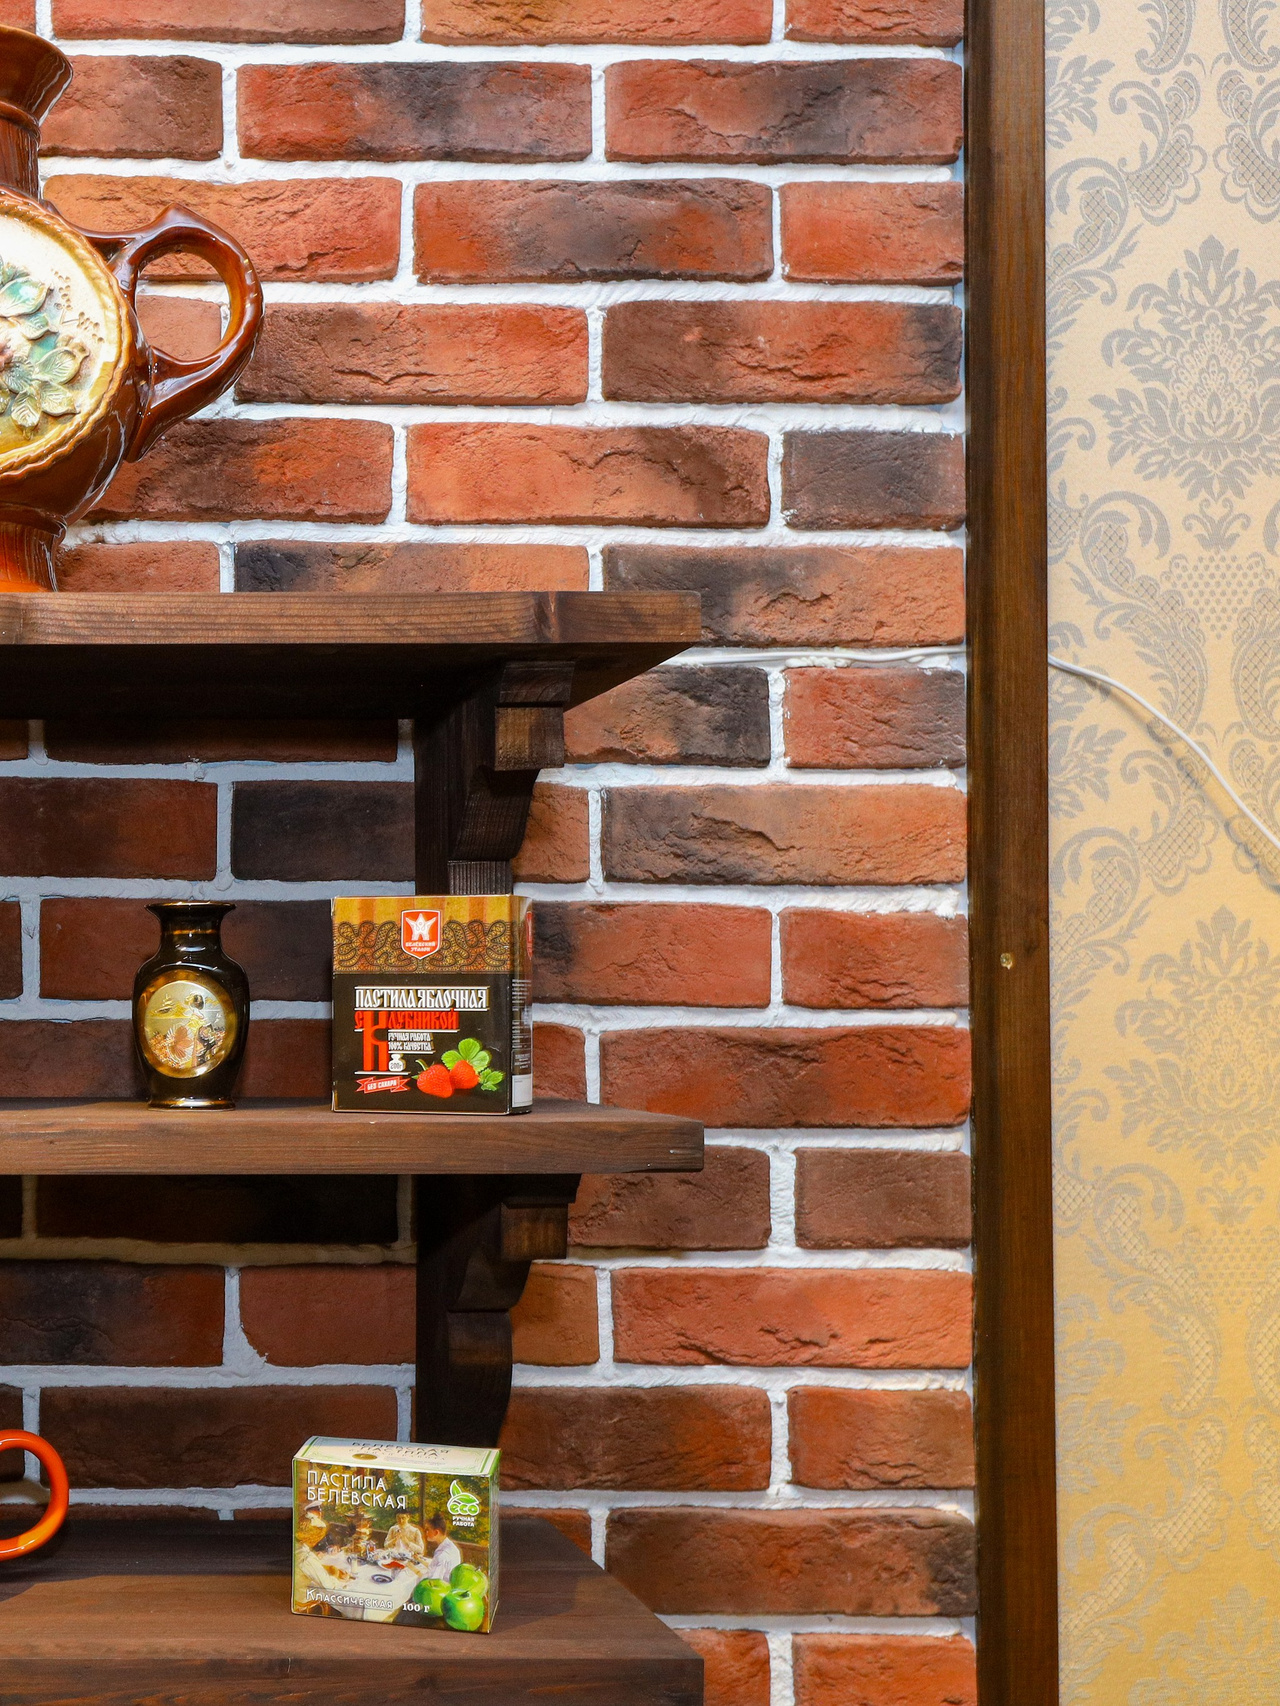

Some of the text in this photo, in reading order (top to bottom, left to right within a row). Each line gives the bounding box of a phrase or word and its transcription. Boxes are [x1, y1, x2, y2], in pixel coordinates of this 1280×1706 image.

[355, 989, 487, 1008] ПАСТИЛА ЯБЛОЧНАЯ
[307, 1470, 387, 1492] ПАСТИЛА
[307, 1486, 407, 1510] БЕЛЁВСКАЯ
[403, 1603, 421, 1612] 100
